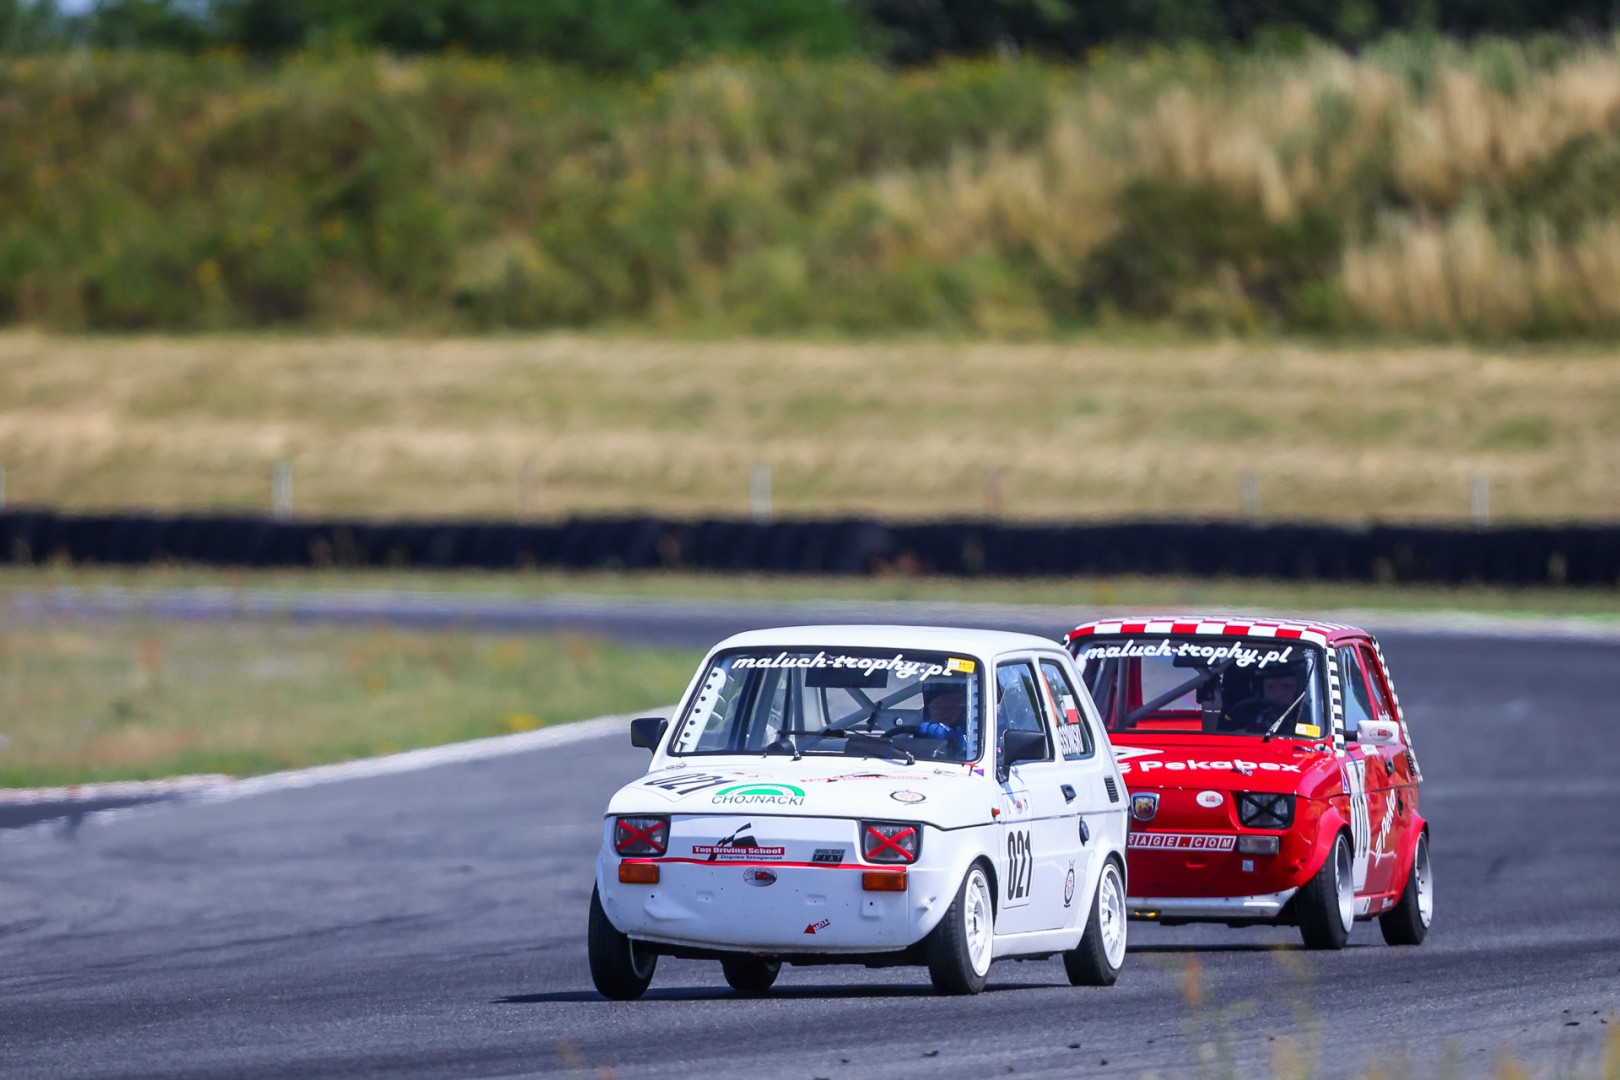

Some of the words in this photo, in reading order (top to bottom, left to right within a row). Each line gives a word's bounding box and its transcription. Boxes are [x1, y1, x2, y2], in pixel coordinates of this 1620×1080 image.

[1084, 638, 1292, 669] maluch-trophy.pl
[731, 651, 952, 681] maluch-trophy.pl
[1139, 759, 1301, 773] Pekabex
[643, 773, 738, 795] 021
[711, 794, 805, 806] CHOJNACKI
[694, 846, 711, 854] Top
[713, 847, 746, 855] Driving
[1007, 829, 1033, 901] 021
